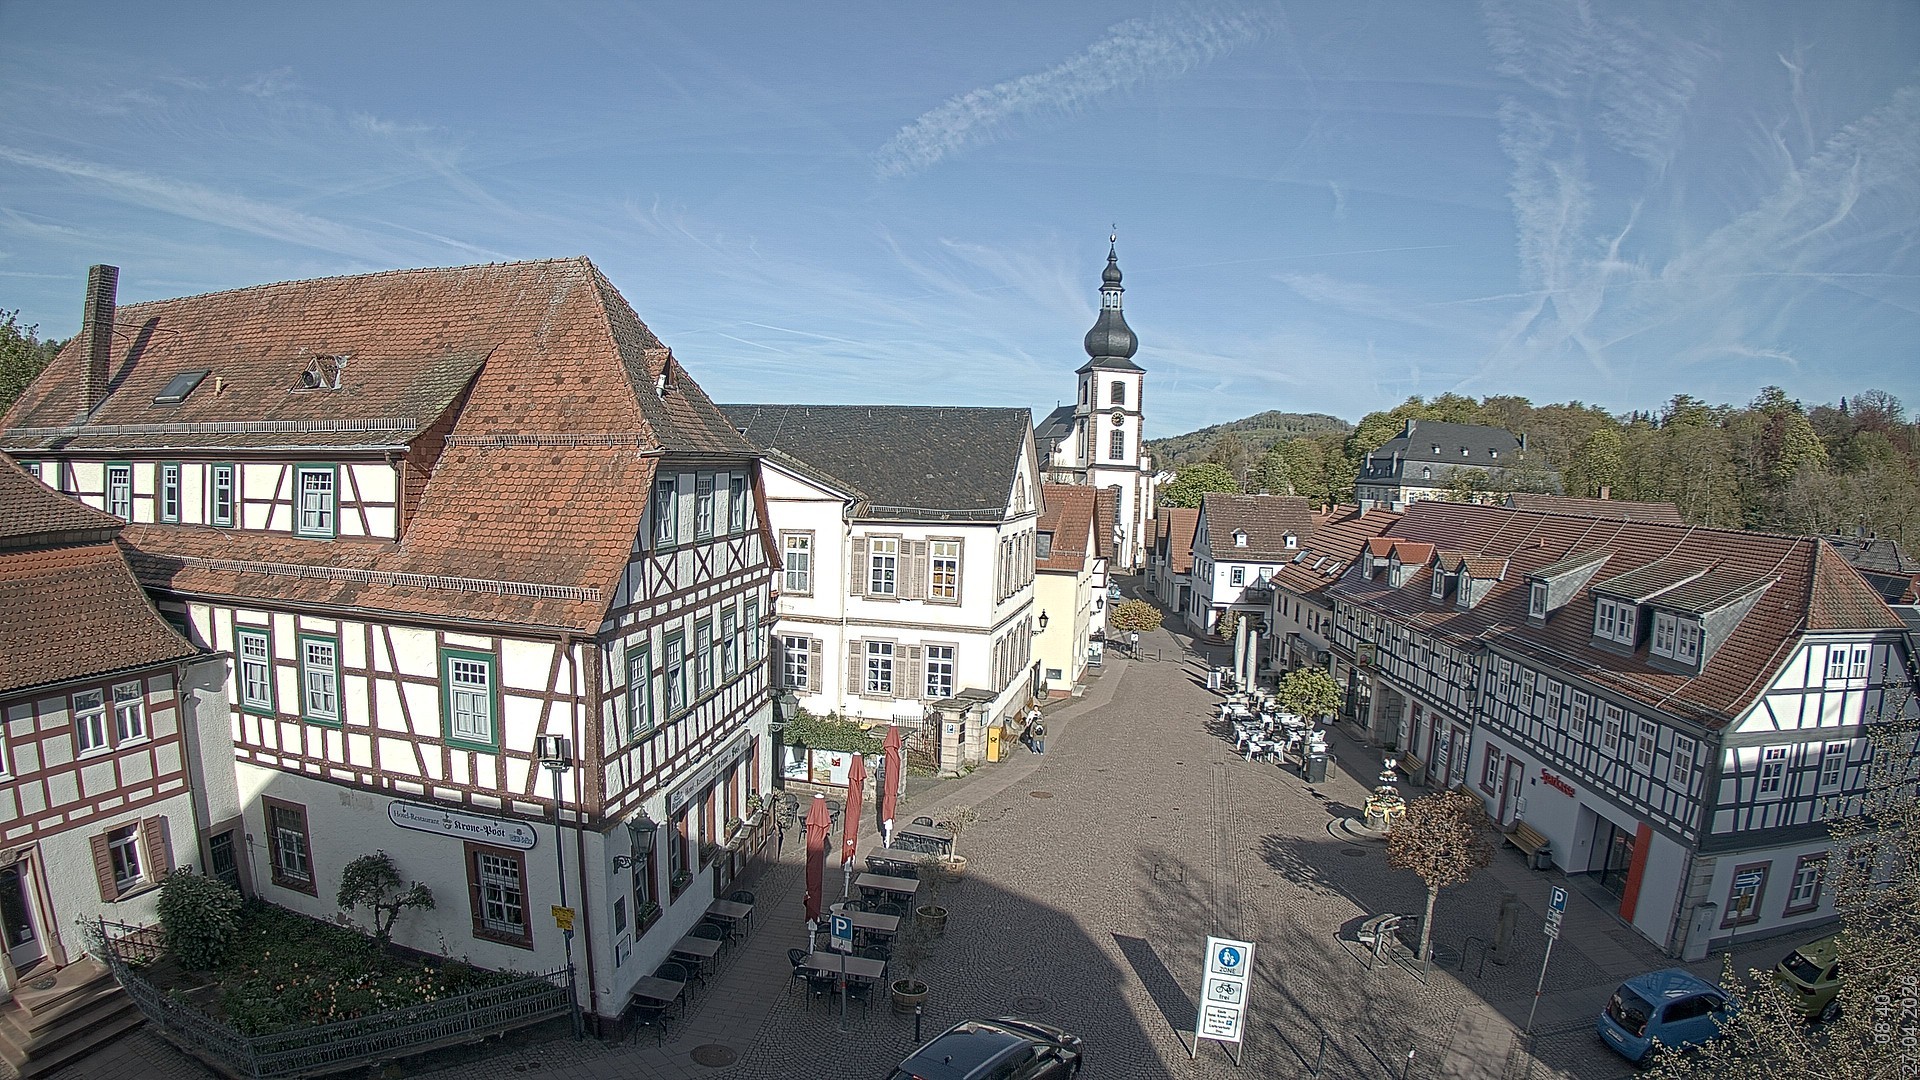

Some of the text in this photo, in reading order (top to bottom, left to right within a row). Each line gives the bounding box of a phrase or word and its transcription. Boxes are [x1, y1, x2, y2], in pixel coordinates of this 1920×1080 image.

[1541, 768, 1575, 797] Sparkasse
[454, 820, 505, 837] Krone-Post
[1553, 890, 1564, 906] P
[836, 918, 847, 935] P
[1219, 966, 1236, 975] ZONE
[1219, 993, 1230, 1001] frei
